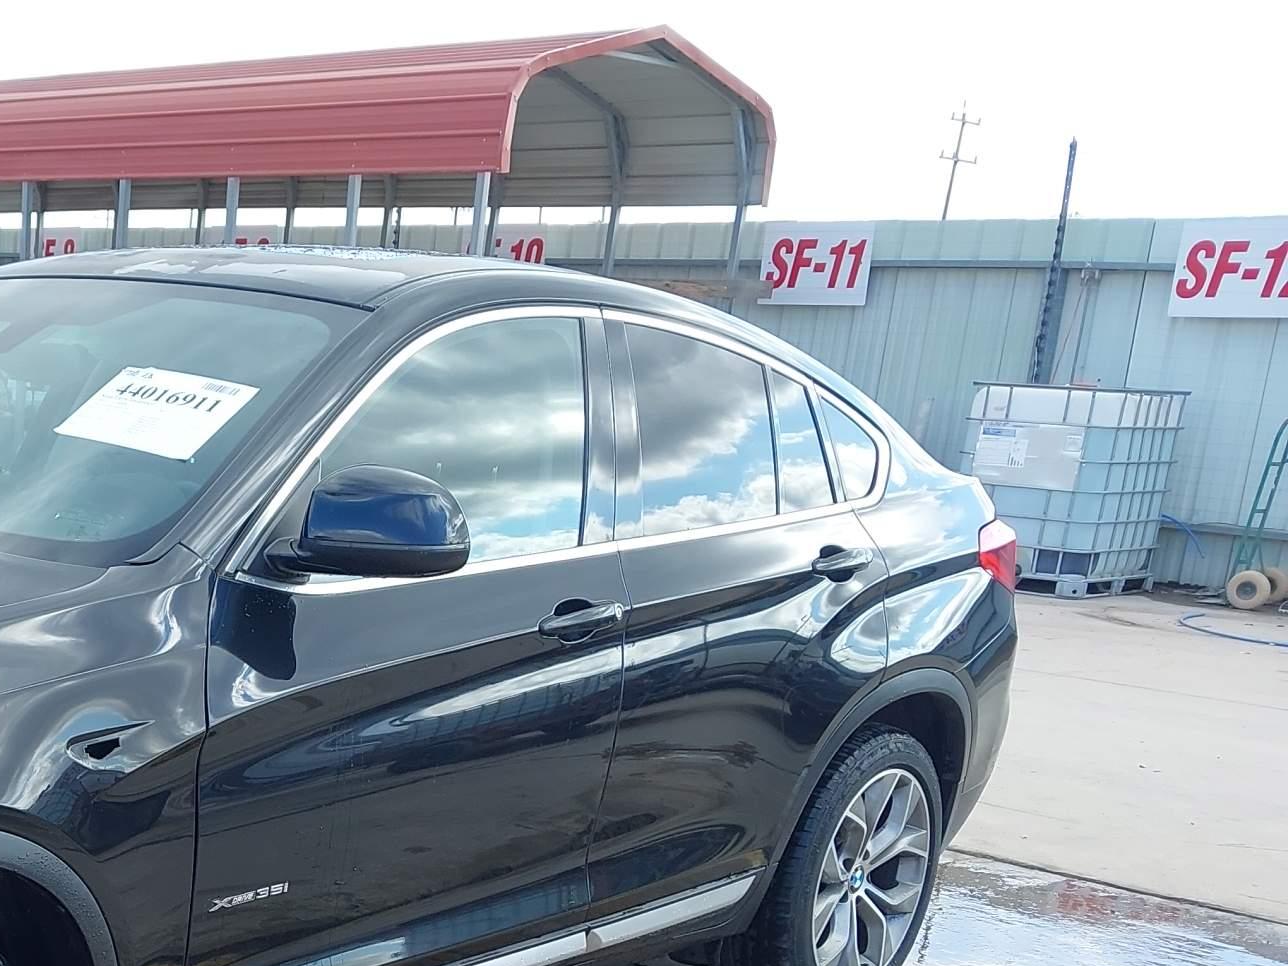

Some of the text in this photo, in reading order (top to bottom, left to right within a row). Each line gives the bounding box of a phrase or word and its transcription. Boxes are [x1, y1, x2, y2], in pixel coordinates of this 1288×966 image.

[765, 238, 868, 289] SF-11
[1175, 240, 1288, 299] SF-1
[116, 383, 221, 412] 44016911
